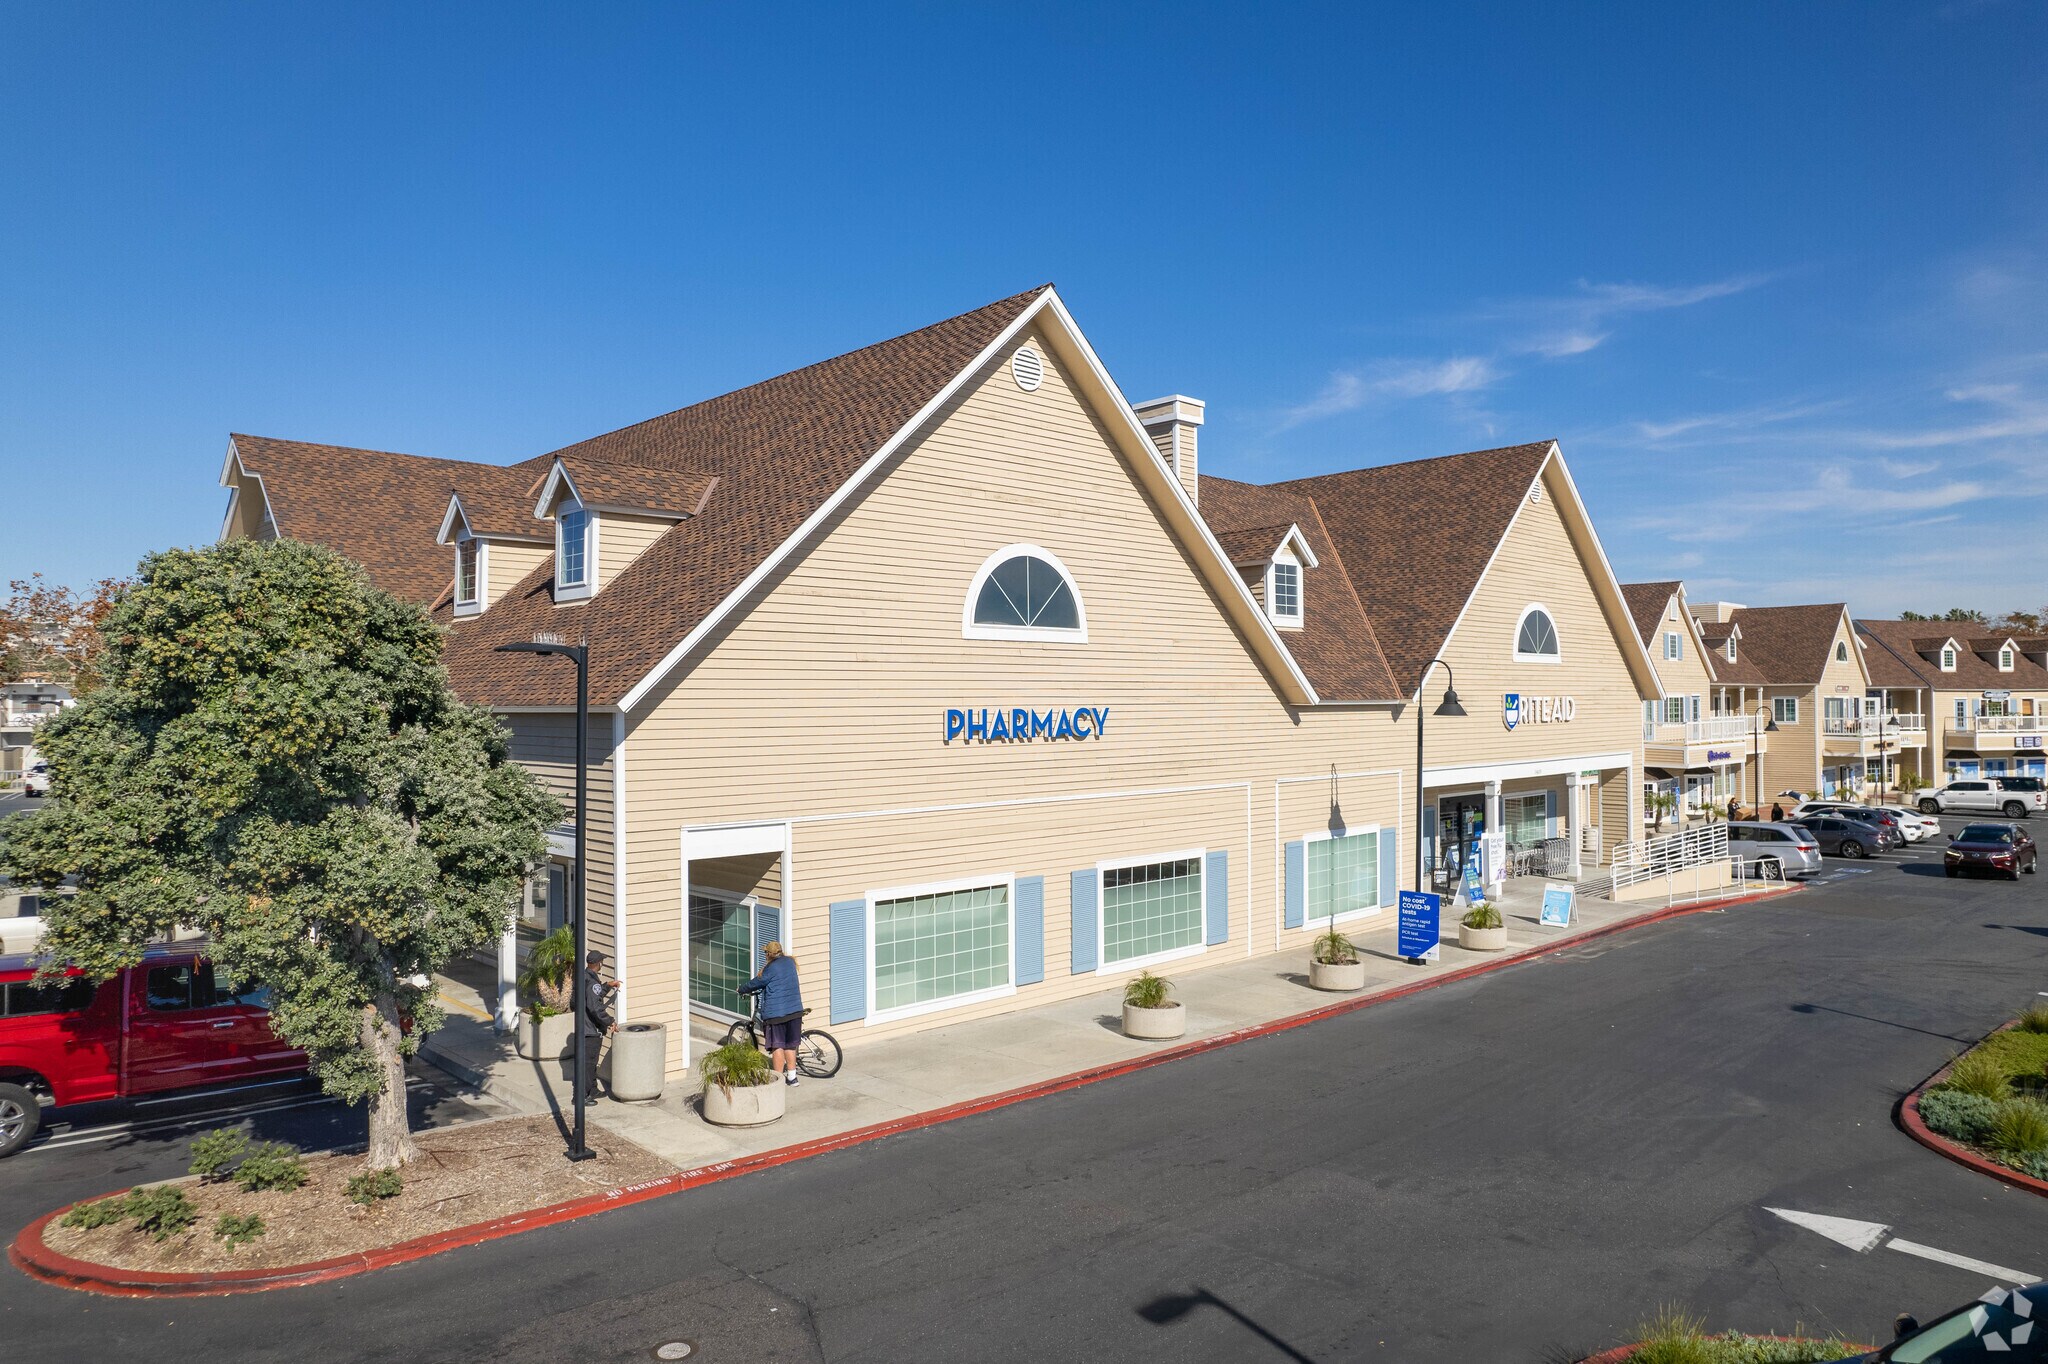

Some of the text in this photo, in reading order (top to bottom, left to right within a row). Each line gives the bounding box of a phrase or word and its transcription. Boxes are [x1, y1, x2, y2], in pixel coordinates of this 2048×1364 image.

[944, 707, 1110, 743] PHARMACY
[1519, 695, 1576, 723] RITE AID
[1402, 903, 1430, 911] COVID-19
[606, 1161, 736, 1199] NO PARKING FIRE LANE
